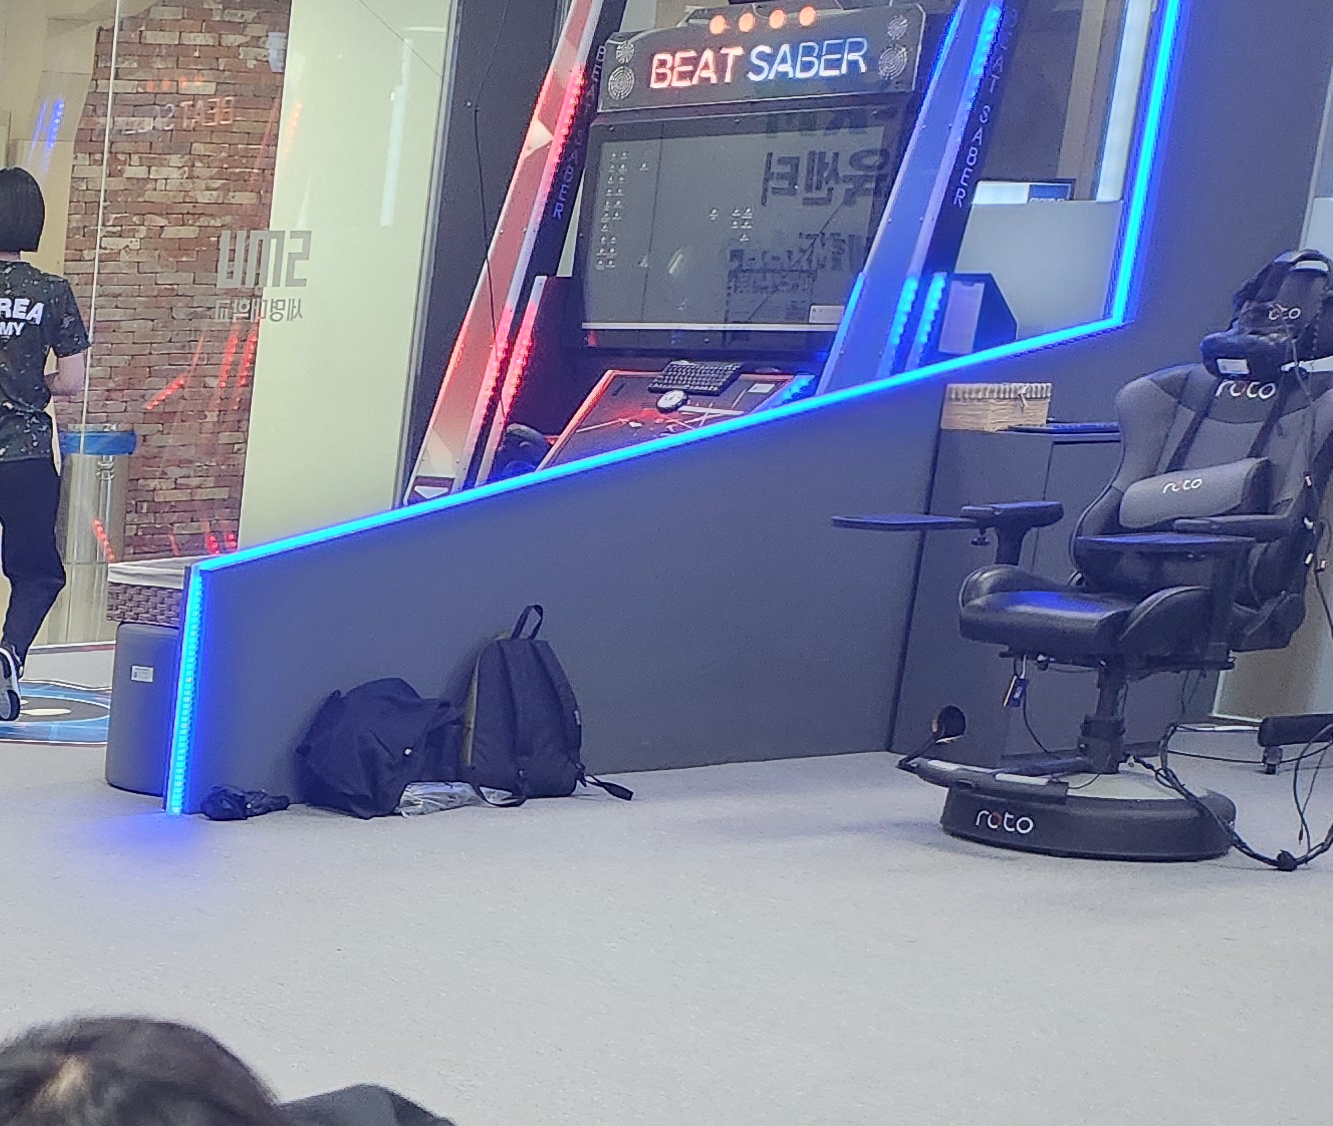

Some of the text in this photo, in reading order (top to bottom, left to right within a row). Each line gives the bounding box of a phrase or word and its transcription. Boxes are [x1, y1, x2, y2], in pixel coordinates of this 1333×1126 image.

[649, 37, 869, 90] BEAT SABER
[953, 104, 991, 208] SABER
[1215, 380, 1276, 400] roto
[1162, 477, 1203, 494] roto
[976, 809, 1034, 834] roto
